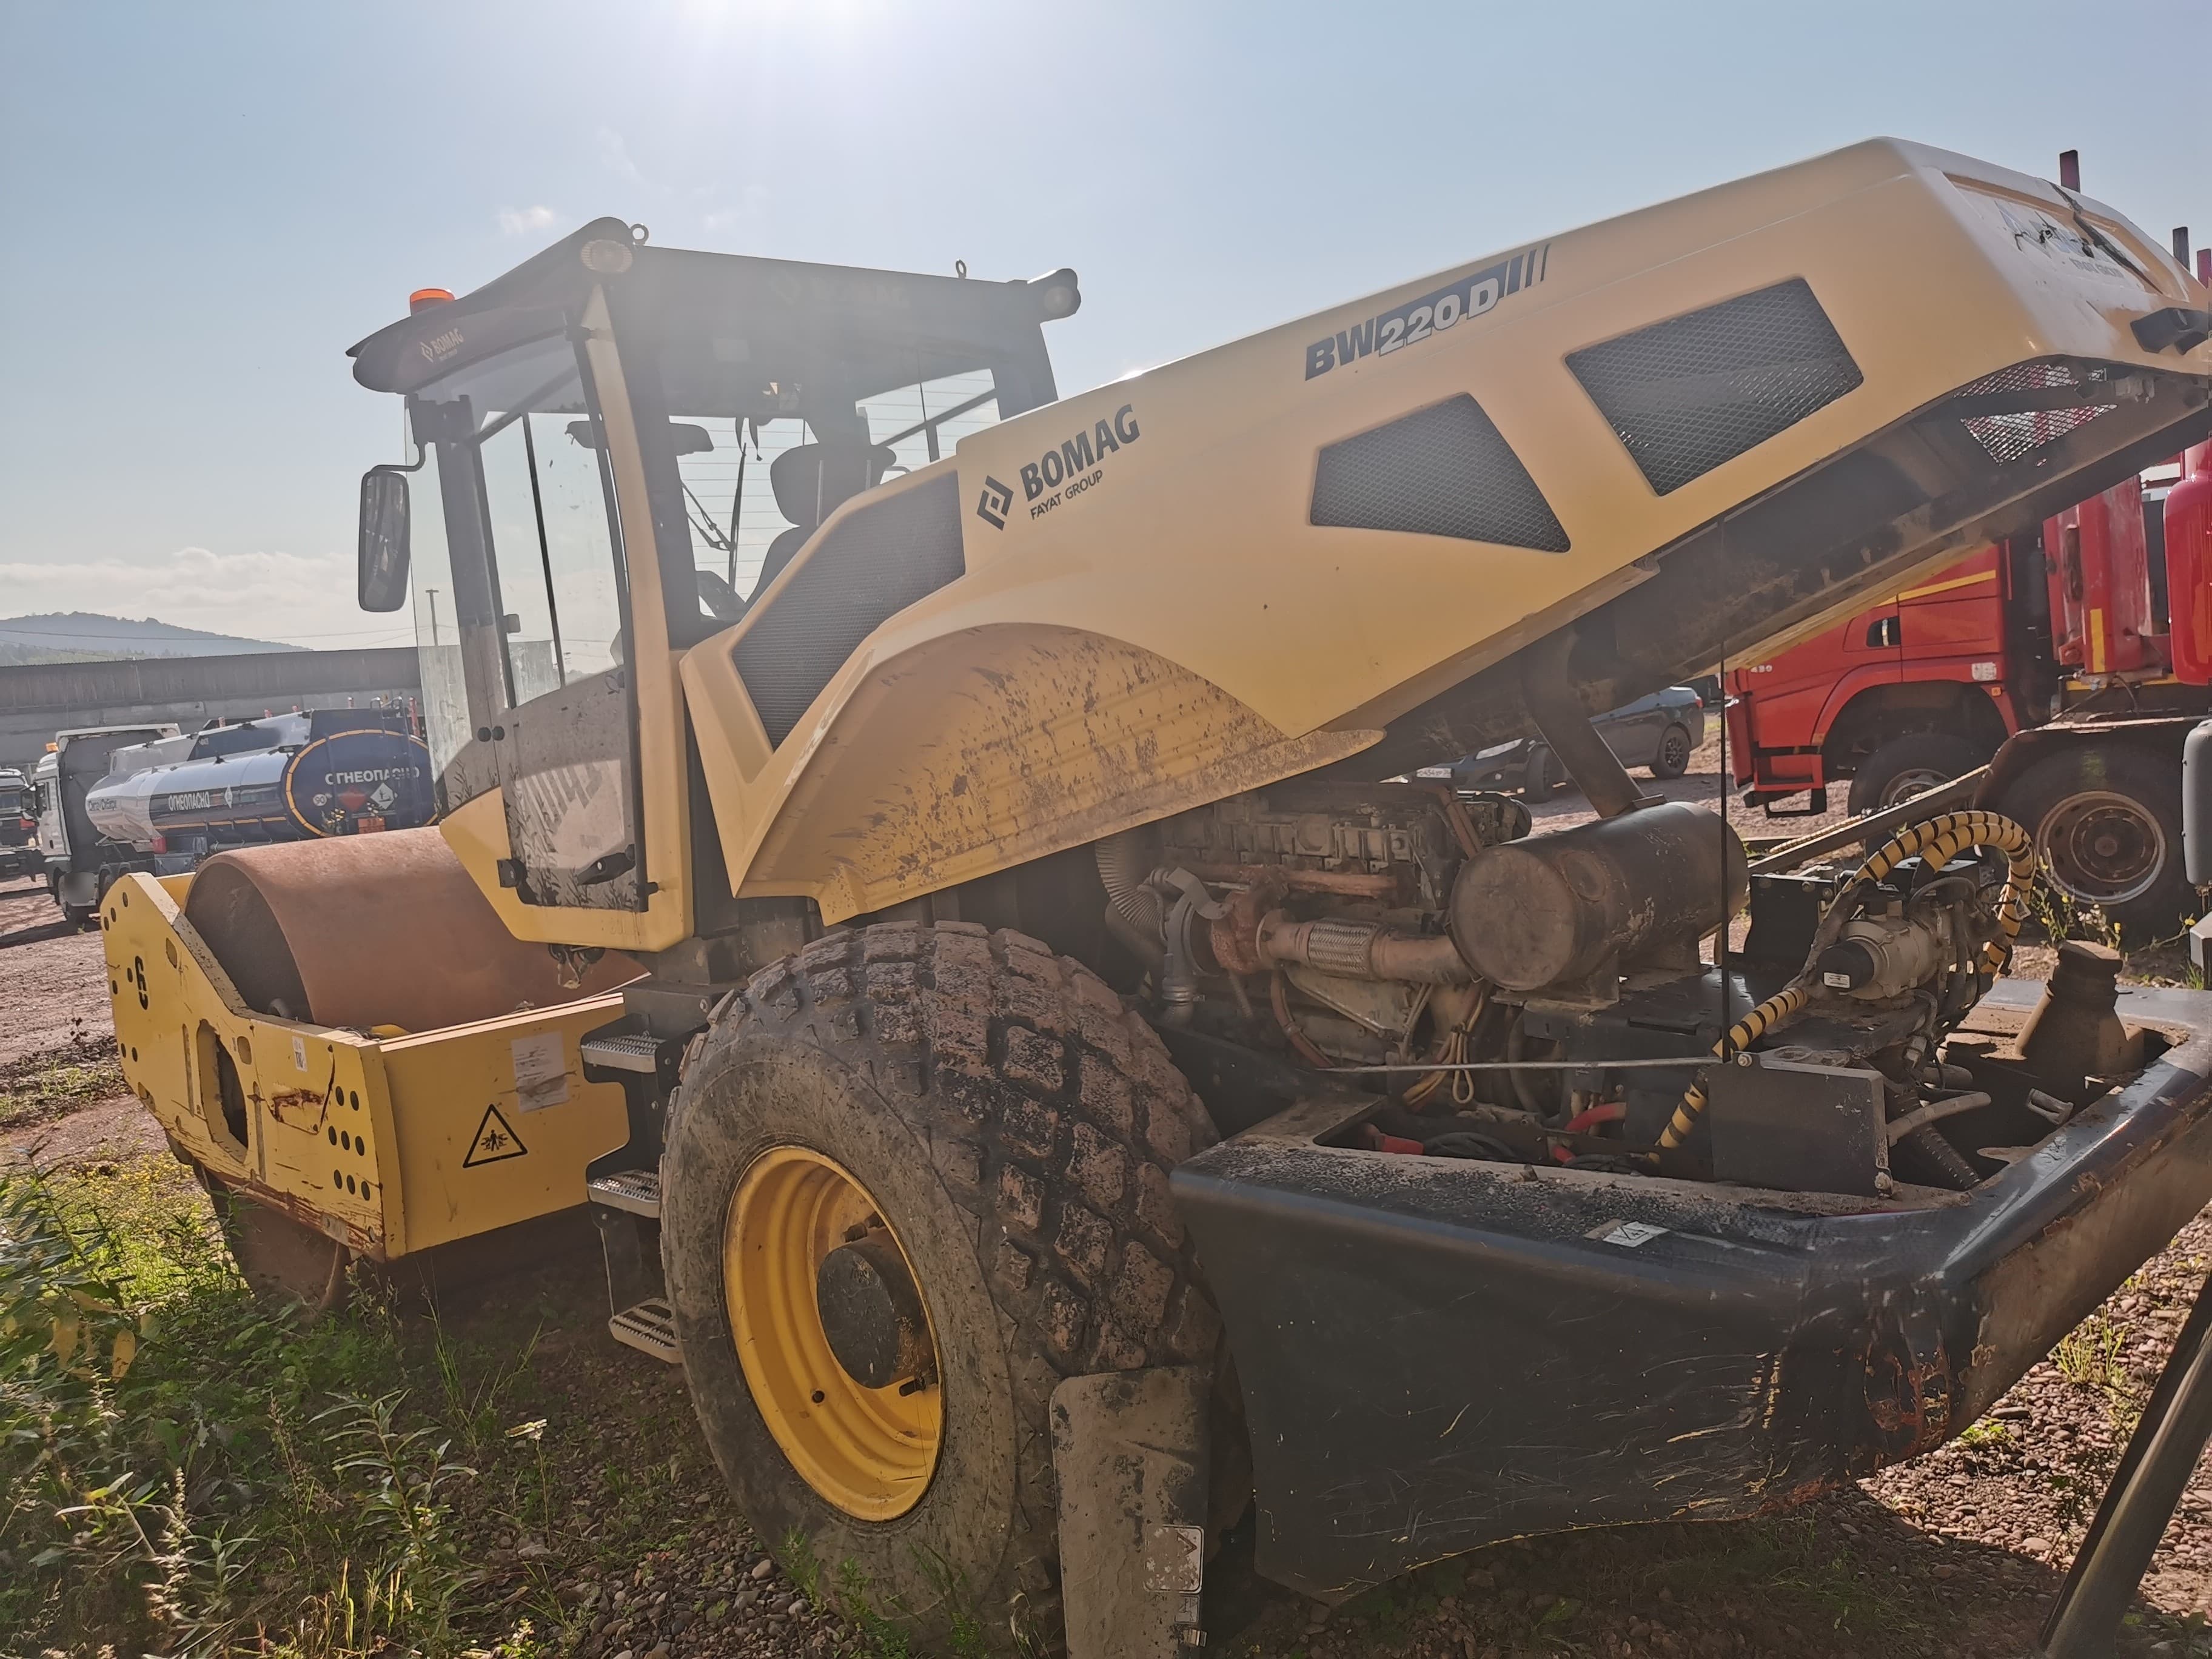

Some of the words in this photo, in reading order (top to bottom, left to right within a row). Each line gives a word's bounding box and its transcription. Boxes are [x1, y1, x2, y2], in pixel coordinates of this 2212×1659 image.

[1467, 277, 1499, 320] D
[430, 328, 463, 354] BOMAG
[1020, 404, 1140, 501] BOMAG
[1030, 493, 1062, 520] FAYAT
[1065, 469, 1103, 499] GROUP
[168, 791, 210, 811] ОГНЕОПАСНО
[315, 796, 325, 805] 90
